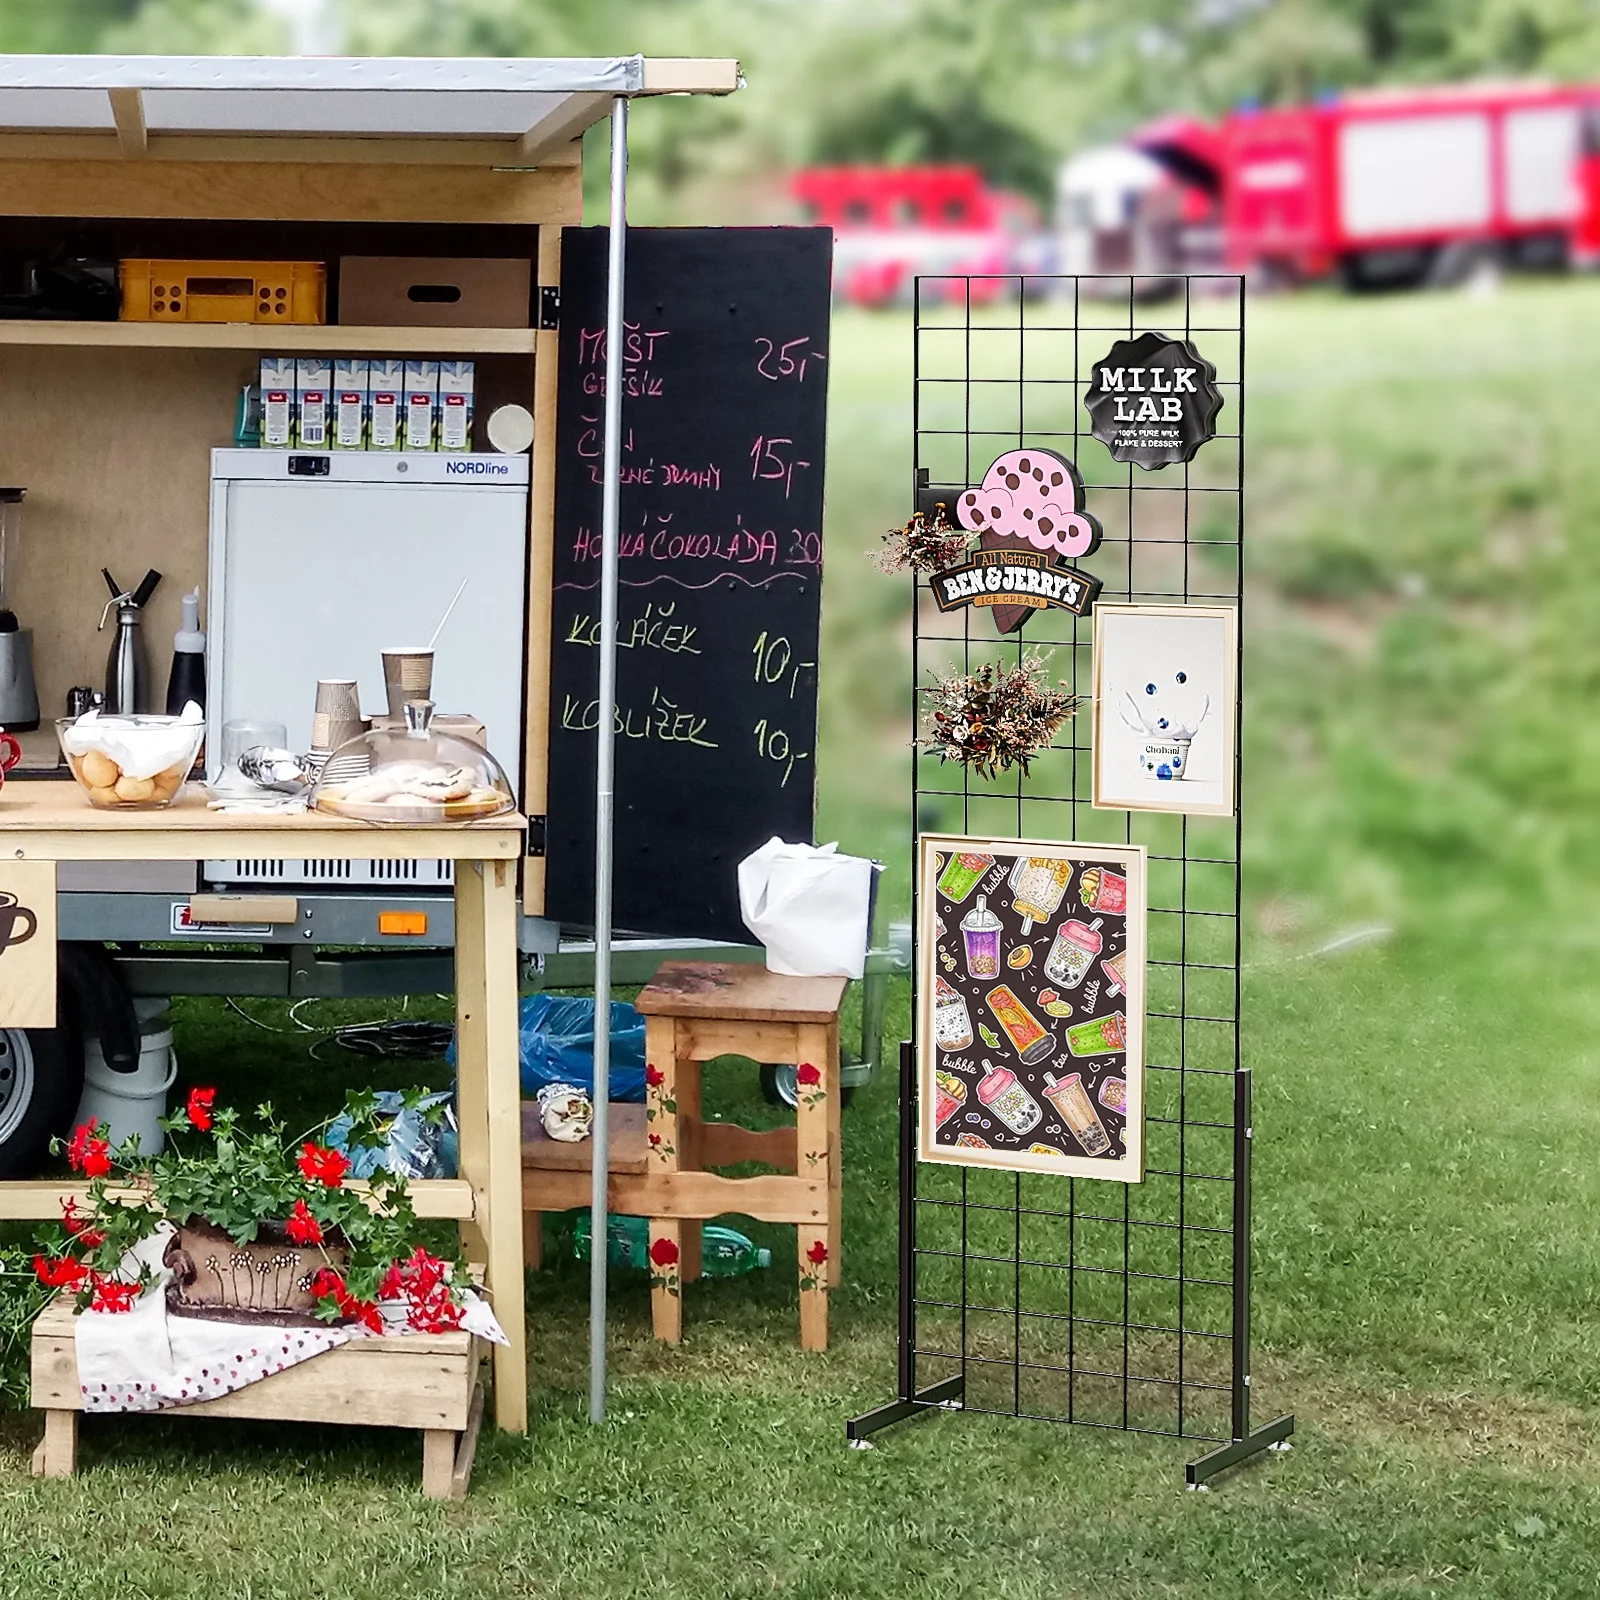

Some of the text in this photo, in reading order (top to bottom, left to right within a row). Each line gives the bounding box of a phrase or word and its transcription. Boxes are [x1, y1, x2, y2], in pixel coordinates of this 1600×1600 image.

[579, 322, 670, 365] MŠT
[1099, 367, 1198, 393] MILK
[1113, 396, 1184, 422] LAB
[577, 415, 633, 456] ČJ
[1117, 429, 1180, 438] 100% PURE MILK
[1140, 439, 1147, 448] &
[1147, 440, 1184, 448] DESSERT
[445, 461, 509, 475] NORDline
[650, 513, 777, 566] ČOKOLÁDA
[981, 552, 1041, 568] All Natural
[980, 595, 1041, 606] ICE CREAM
[1145, 745, 1181, 755] Chobani
[981, 864, 1010, 896] bubble
[1080, 979, 1101, 1015] bubble
[941, 1053, 977, 1075] bubble
[1051, 1052, 1069, 1069] tea
